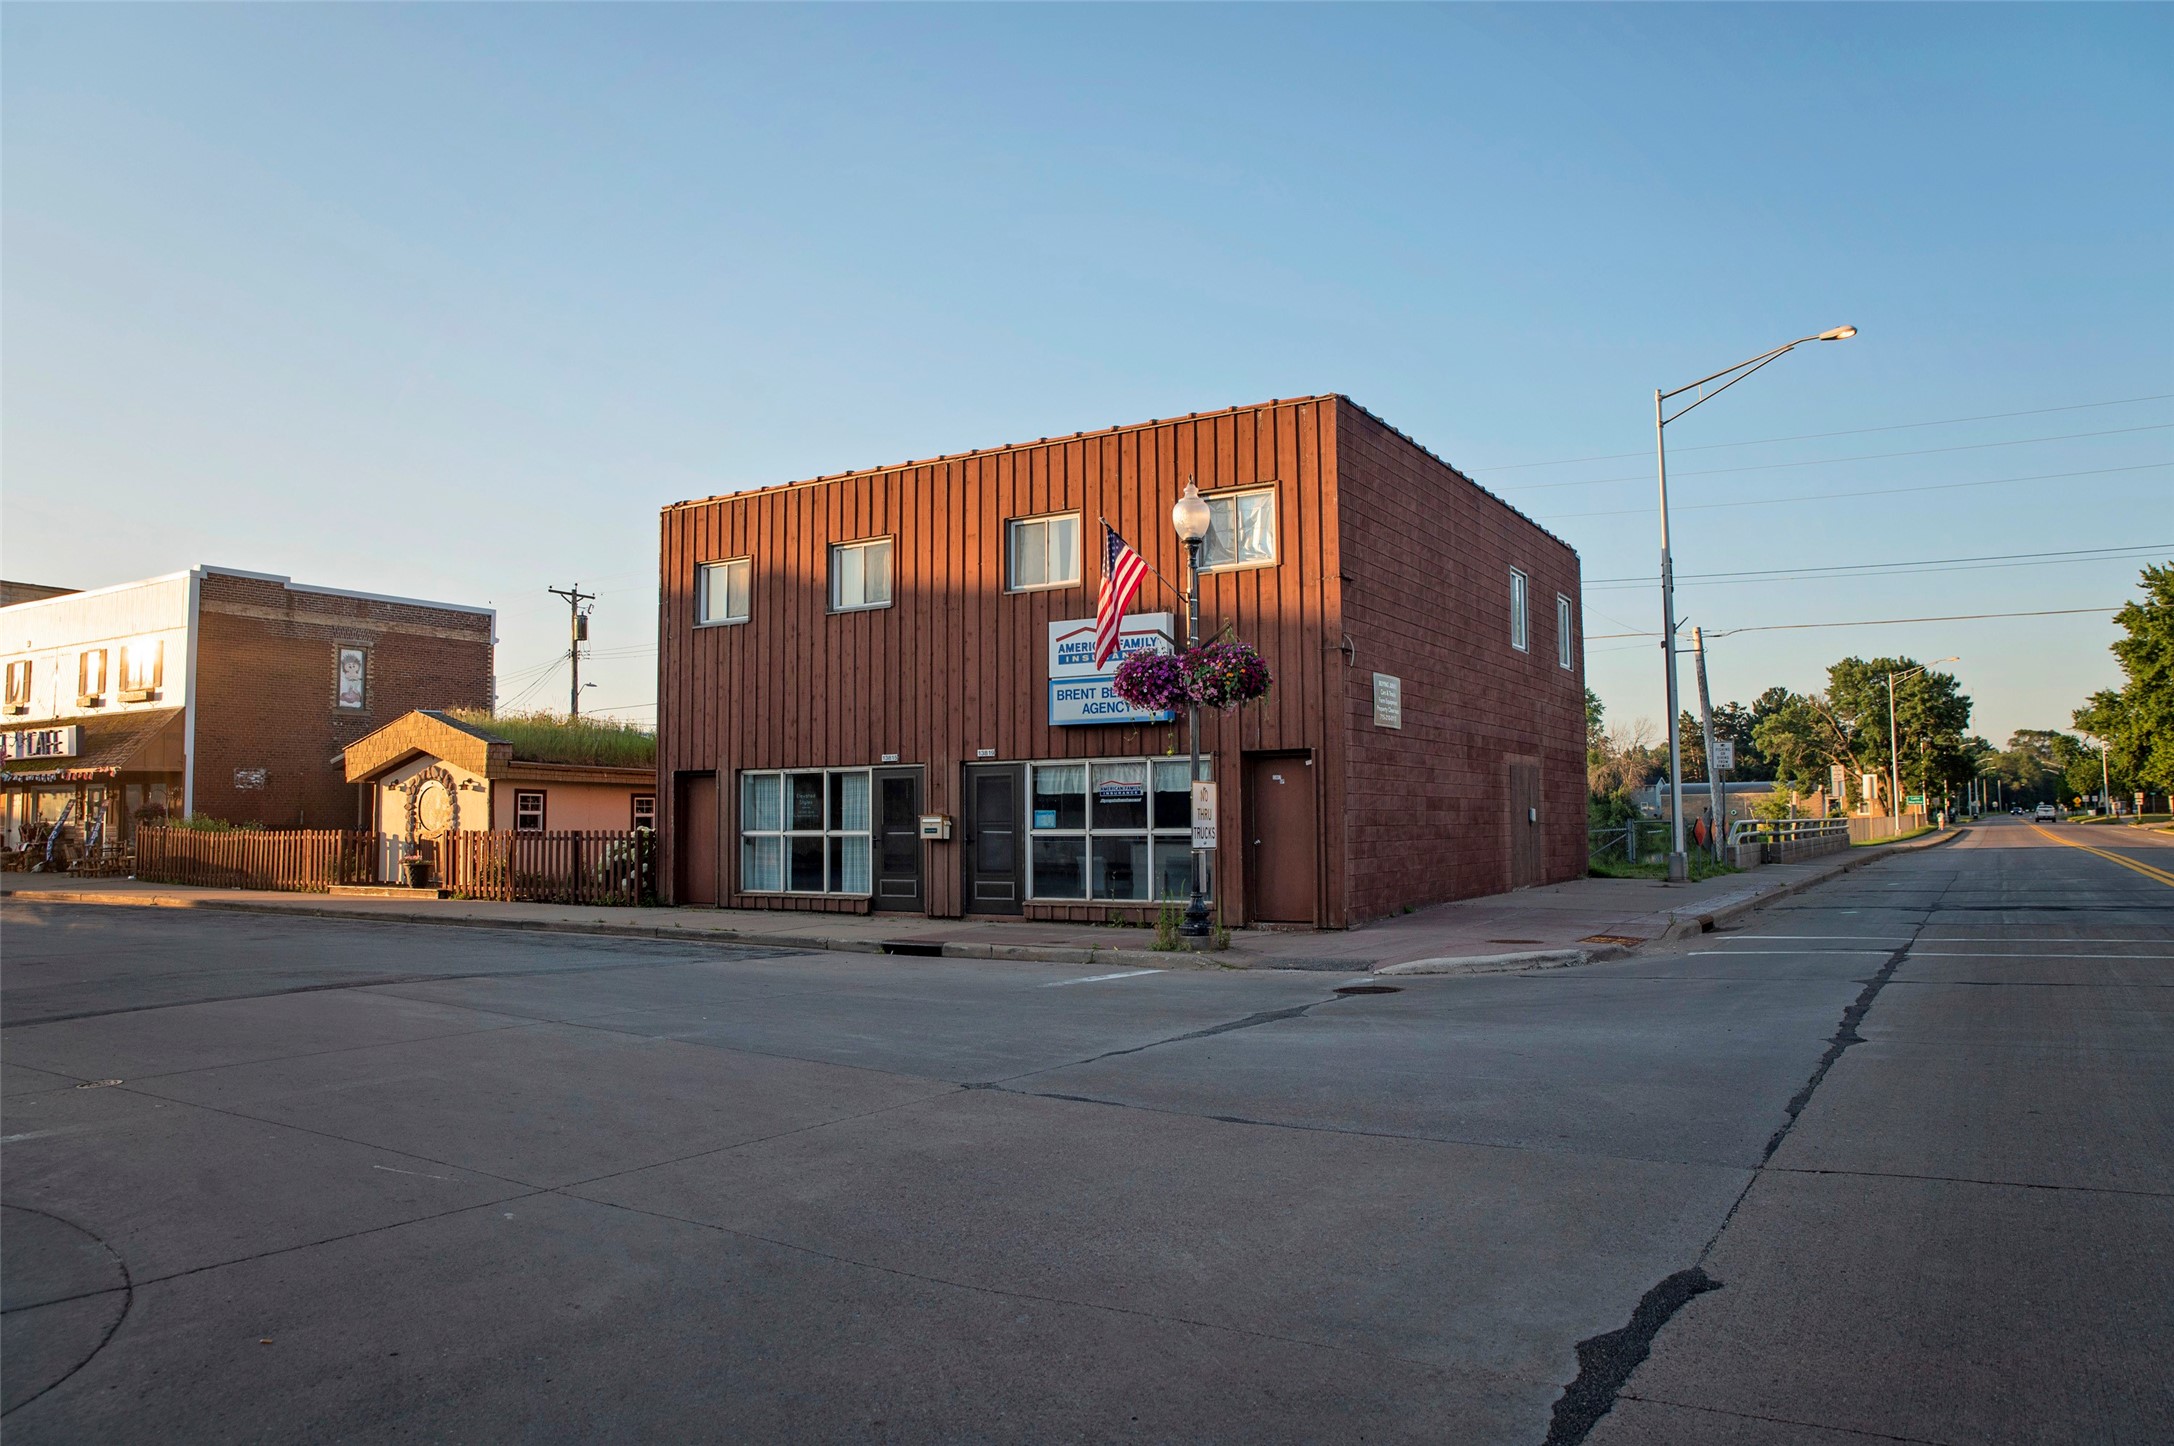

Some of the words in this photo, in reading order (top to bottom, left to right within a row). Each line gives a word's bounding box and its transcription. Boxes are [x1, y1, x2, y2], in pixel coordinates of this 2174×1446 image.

[1057, 688, 1096, 701] BRENT
[1082, 701, 1131, 714] AGENCY
[1200, 789, 1209, 802] NO
[1197, 807, 1212, 821] THRU
[1193, 827, 1215, 840] TRUCKS
